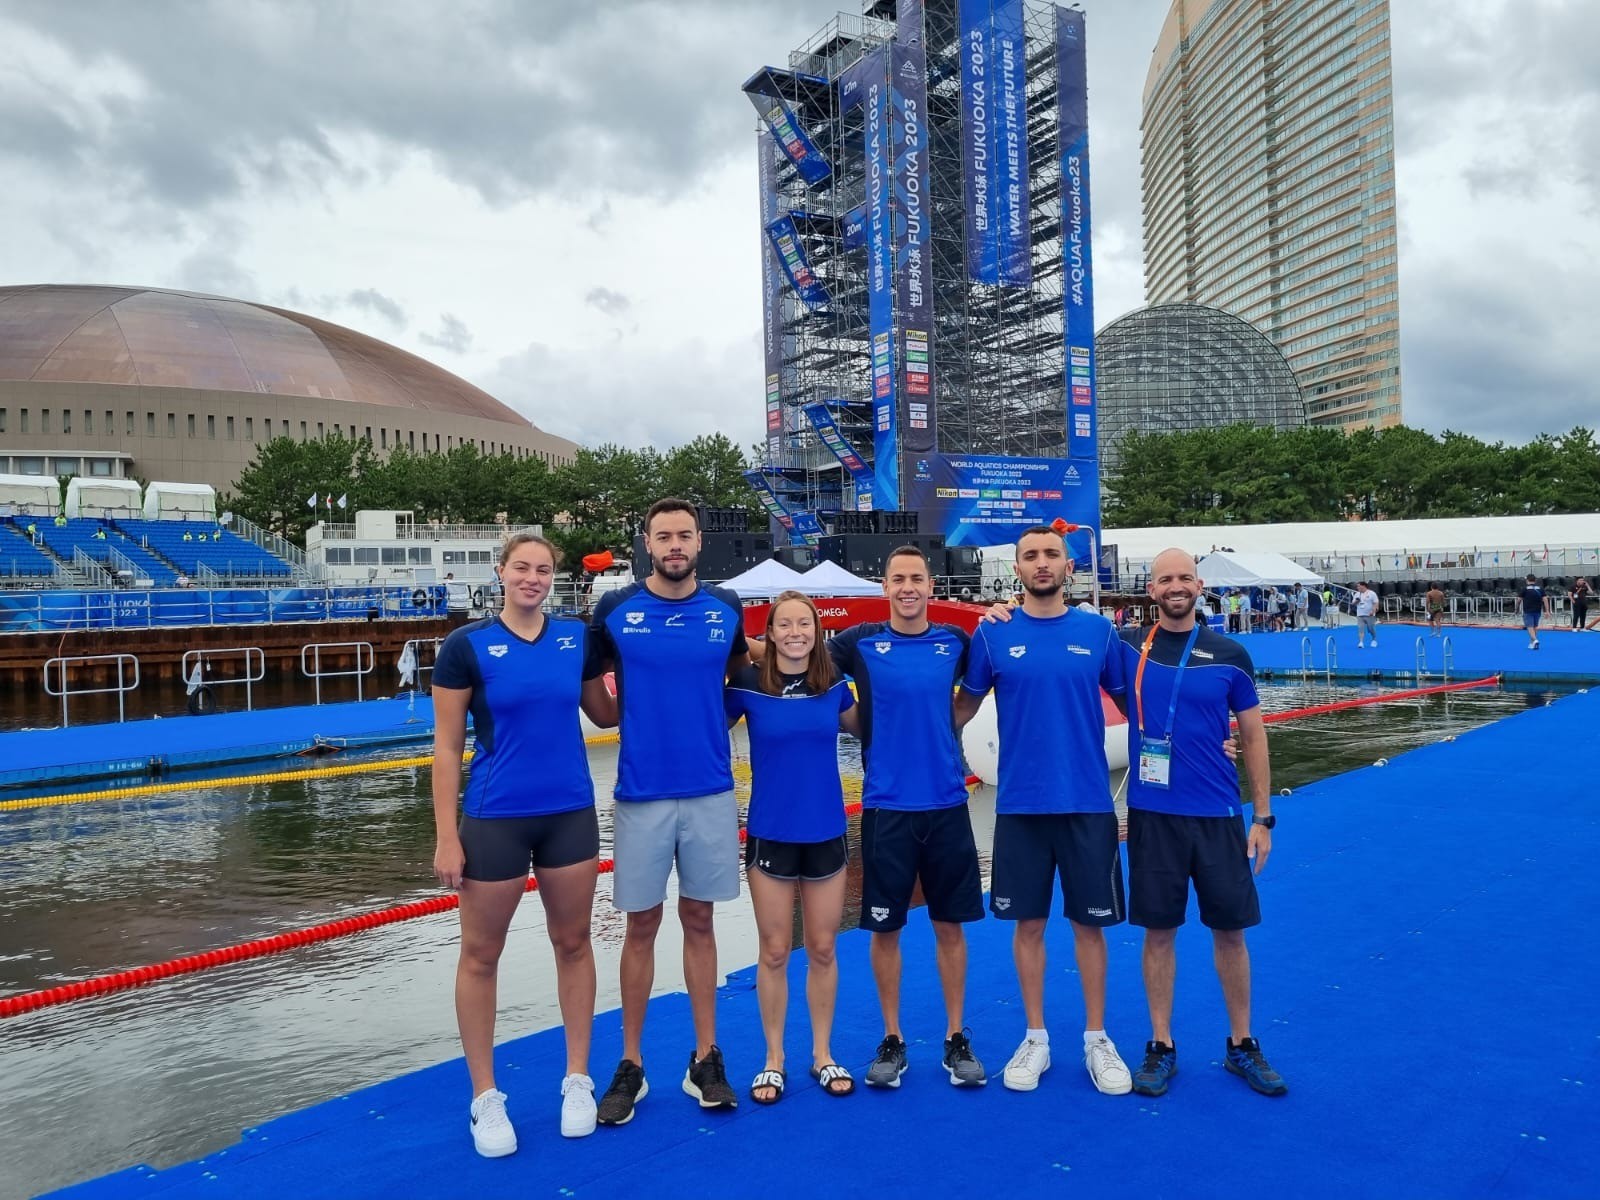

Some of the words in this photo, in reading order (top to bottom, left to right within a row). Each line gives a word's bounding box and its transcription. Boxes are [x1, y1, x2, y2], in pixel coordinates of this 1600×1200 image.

[971, 30, 984, 77] 2023
[1003, 39, 1015, 99] FUTURE
[868, 83, 879, 133] 2023
[904, 98, 918, 147] 2023
[973, 80, 987, 171] FUKUOKA
[1005, 102, 1017, 130] THE
[1007, 131, 1019, 181] MEETS
[760, 145, 772, 246] CHMPIONSHIPS
[870, 135, 882, 231] FUKUOKA
[906, 151, 921, 245] FUKUOKA
[975, 174, 988, 231] 世界水泳
[846, 223, 862, 237] 20m
[1009, 183, 1021, 236] WATER
[1068, 156, 1085, 306] #AQUAFukuoka23
[764, 248, 774, 307] AQUATICS
[872, 231, 885, 292] 世界水泳
[908, 248, 923, 308] 世界水泳
[766, 310, 774, 355] WORLD
[907, 331, 927, 340] Nikon
[974, 462, 1002, 470] AQUATICS
[981, 469, 1007, 477] FUKUOKA
[937, 489, 958, 498] Nikon
[817, 607, 849, 618] OMEGA
